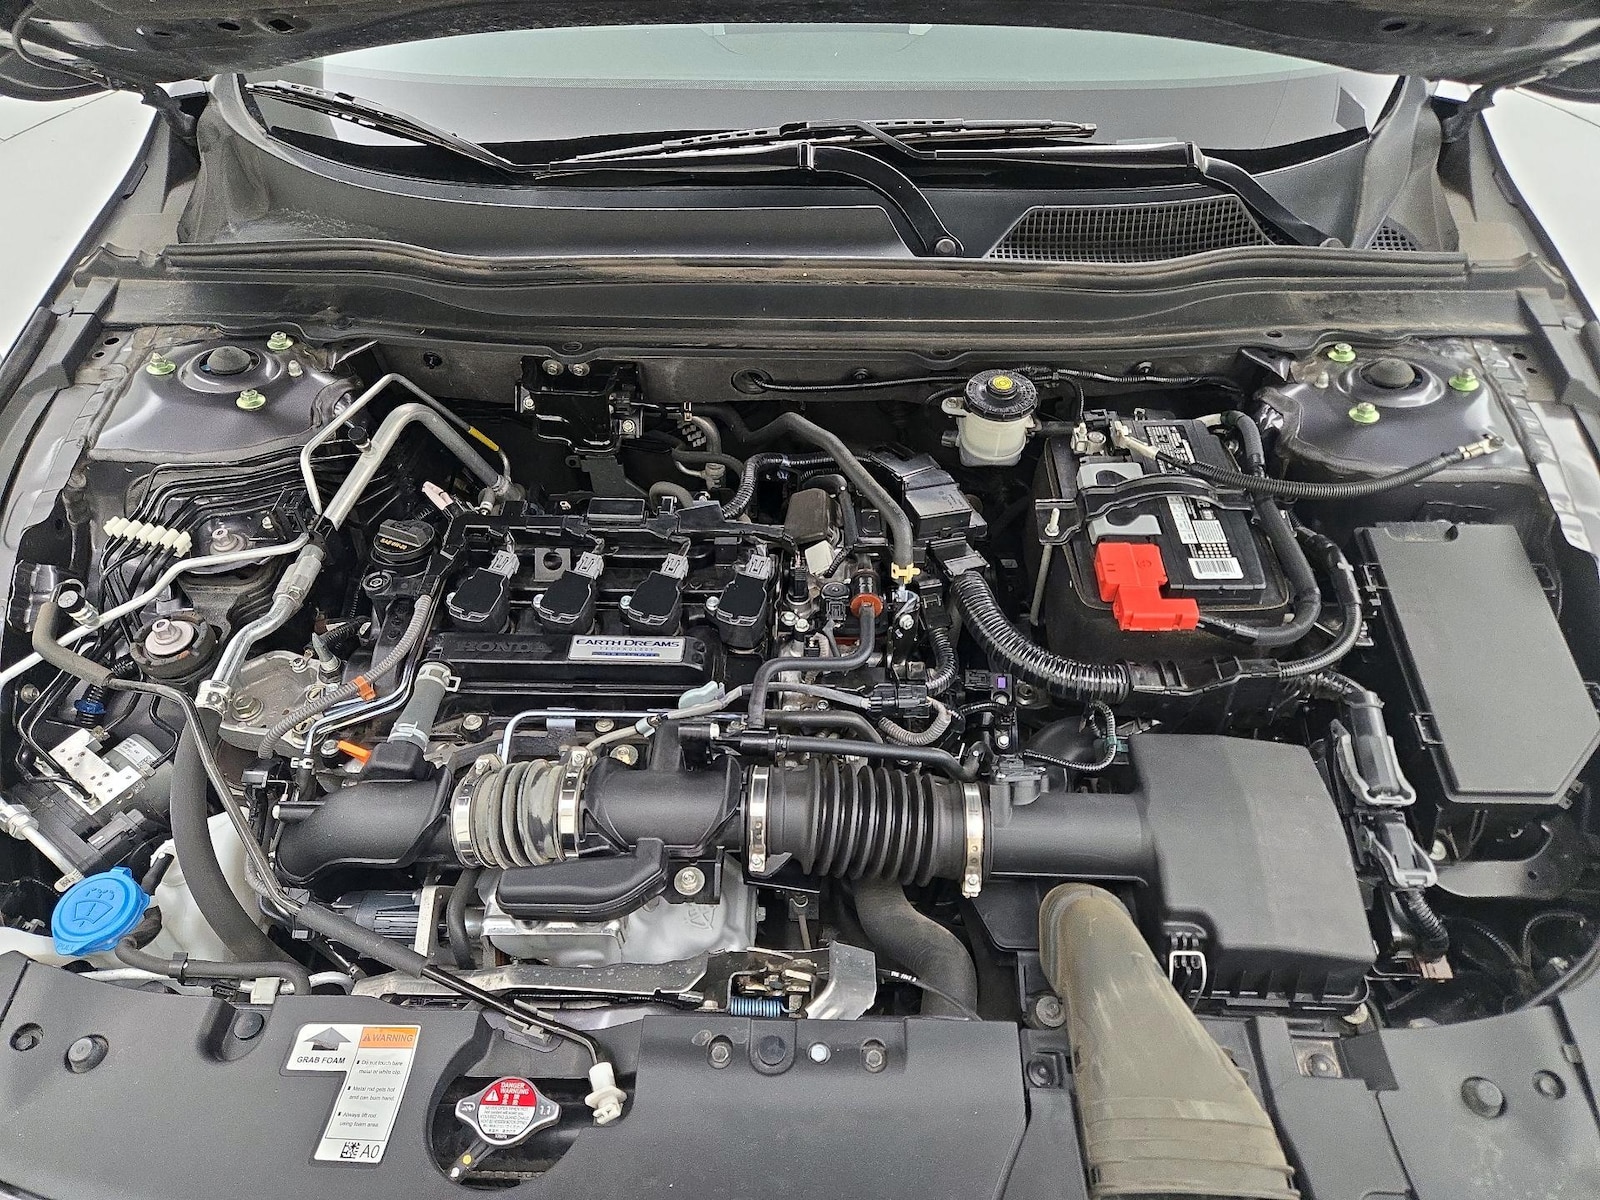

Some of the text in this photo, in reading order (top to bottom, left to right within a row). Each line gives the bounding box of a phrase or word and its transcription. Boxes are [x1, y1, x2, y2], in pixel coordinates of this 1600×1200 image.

[454, 640, 552, 653] HONDA
[624, 639, 680, 648] DREAMS
[372, 1034, 413, 1042] WARNING
[297, 1056, 320, 1064] GRAB
[540, 1105, 551, 1115] 1.1
[359, 1144, 380, 1159] A0
